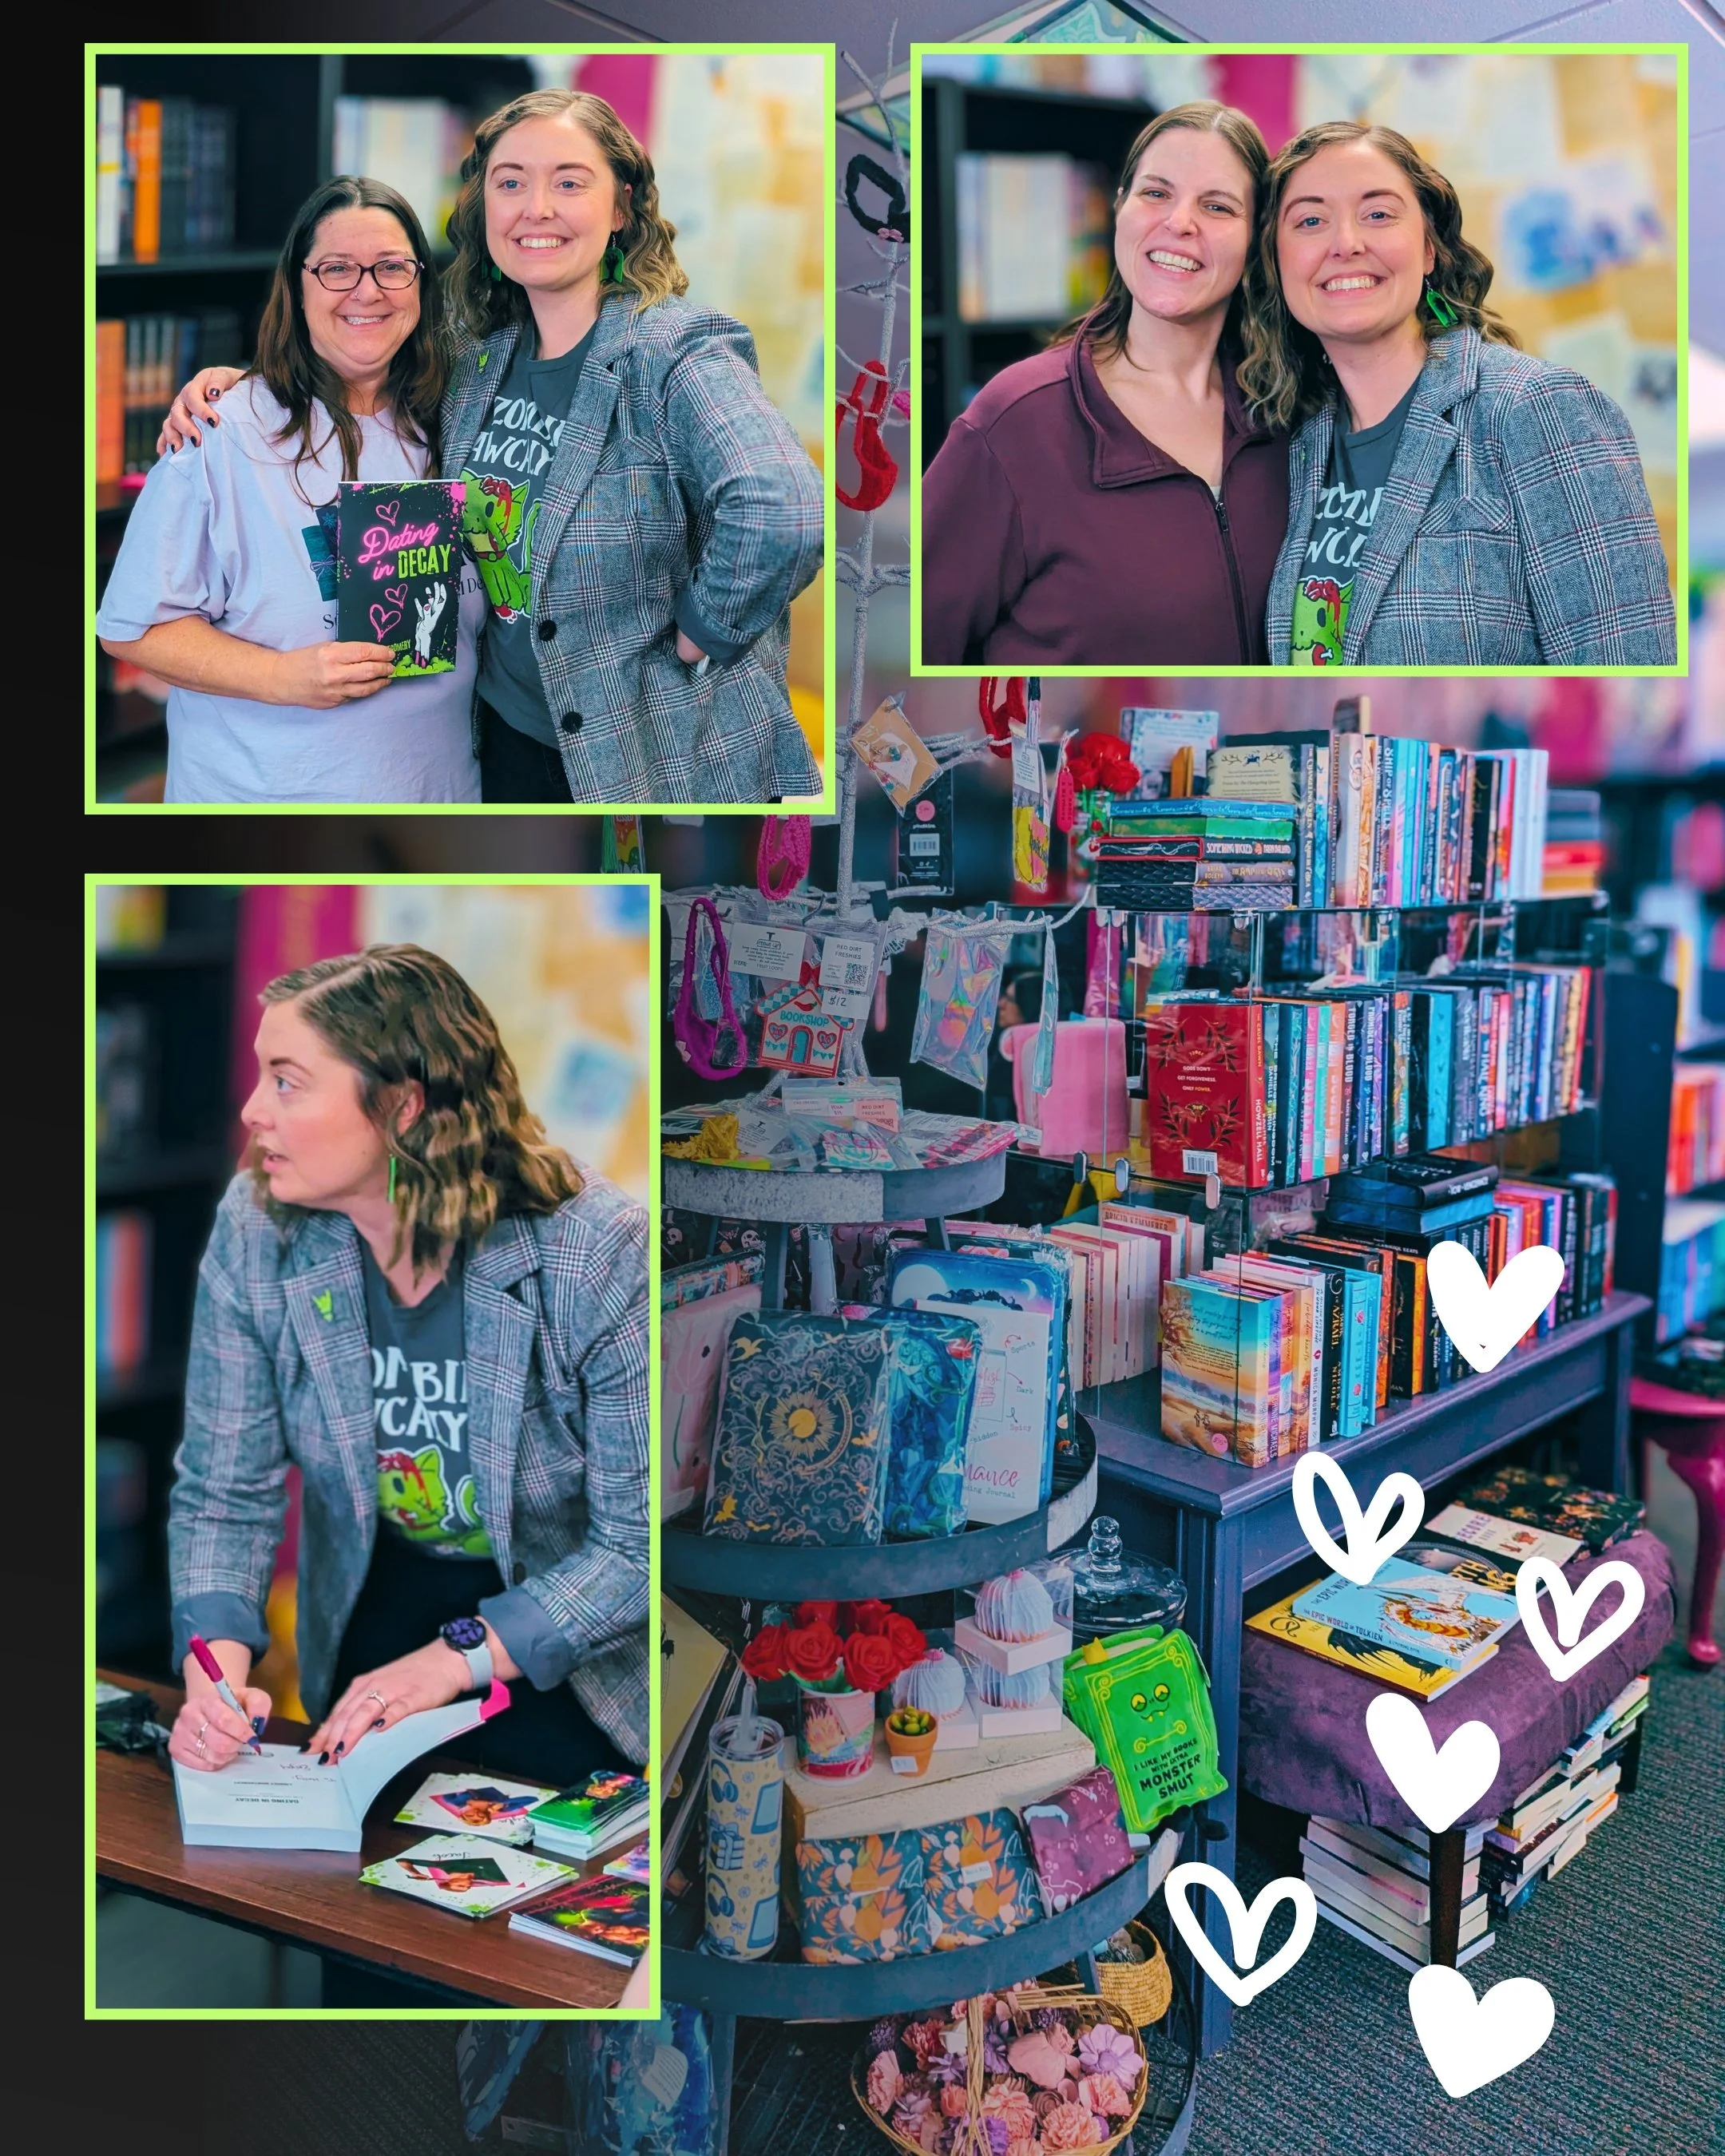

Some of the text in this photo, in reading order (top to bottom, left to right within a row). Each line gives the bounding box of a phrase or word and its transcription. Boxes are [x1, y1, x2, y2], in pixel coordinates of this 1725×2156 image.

[359, 523, 438, 564] Dating
[373, 544, 451, 580] in DECAY
[1385, 747, 1394, 777] SHIP
[1383, 788, 1394, 830] SPELLS
[835, 951, 862, 960] FRESHIES
[827, 995, 847, 1007] $12
[779, 1009, 830, 1027] BOOKSHOP
[1346, 1008, 1356, 1041] FORGED
[1345, 1054, 1354, 1083] BLOOD
[1365, 1056, 1374, 1081] BLOOD
[1330, 1305, 1341, 1349] AZRAEL
[1010, 1341, 1036, 1354] Sports
[1016, 1385, 1034, 1395] Dark
[1330, 1366, 1338, 1409] NICOLE
[1270, 1394, 1279, 1422] CORINNE
[1009, 1424, 1032, 1433] Spicy
[1269, 1424, 1279, 1459] MICHAELS
[985, 1487, 1017, 1500] Journal
[1316, 1584, 1338, 1601] EPIC
[1311, 1611, 1325, 1622] EPIC
[1326, 1615, 1349, 1630] WORLD
[1355, 1626, 1383, 1642] TOLKIEN
[1140, 1758, 1157, 1769] LIKE
[1160, 1750, 1172, 1761] MY
[1172, 1737, 1197, 1754] BOOKS
[1151, 1751, 1189, 1774] WITH EXTRA
[1139, 1753, 1201, 1792] MONSTER
[1159, 1772, 1194, 1799] SMUT
